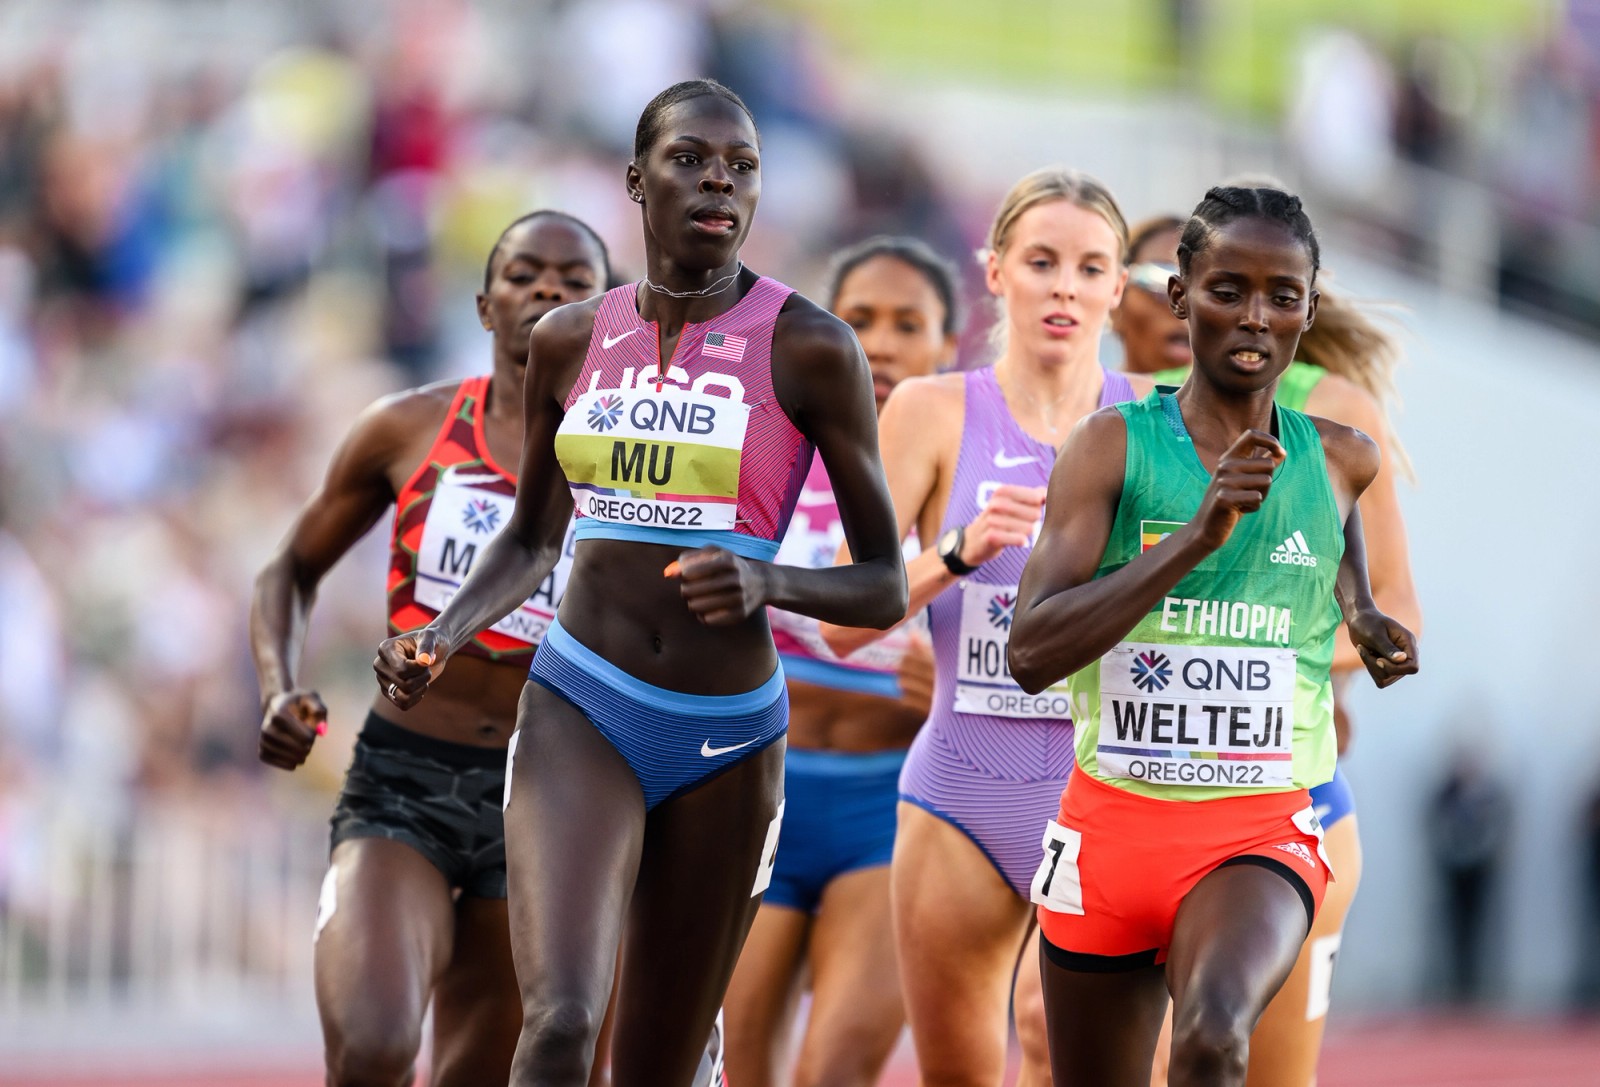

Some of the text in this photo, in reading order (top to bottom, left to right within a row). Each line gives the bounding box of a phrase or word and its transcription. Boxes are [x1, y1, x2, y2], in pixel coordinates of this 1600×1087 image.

[630, 398, 716, 435] QNB
[611, 441, 675, 486] MU
[589, 496, 703, 526] OREGON22
[1270, 551, 1317, 568] adidas
[1160, 596, 1291, 644] ETHIOPIA
[1182, 658, 1271, 691] QNB
[1112, 700, 1283, 747] WELTEJI
[1128, 760, 1263, 784] OREGON22
[1041, 838, 1065, 896] 7
